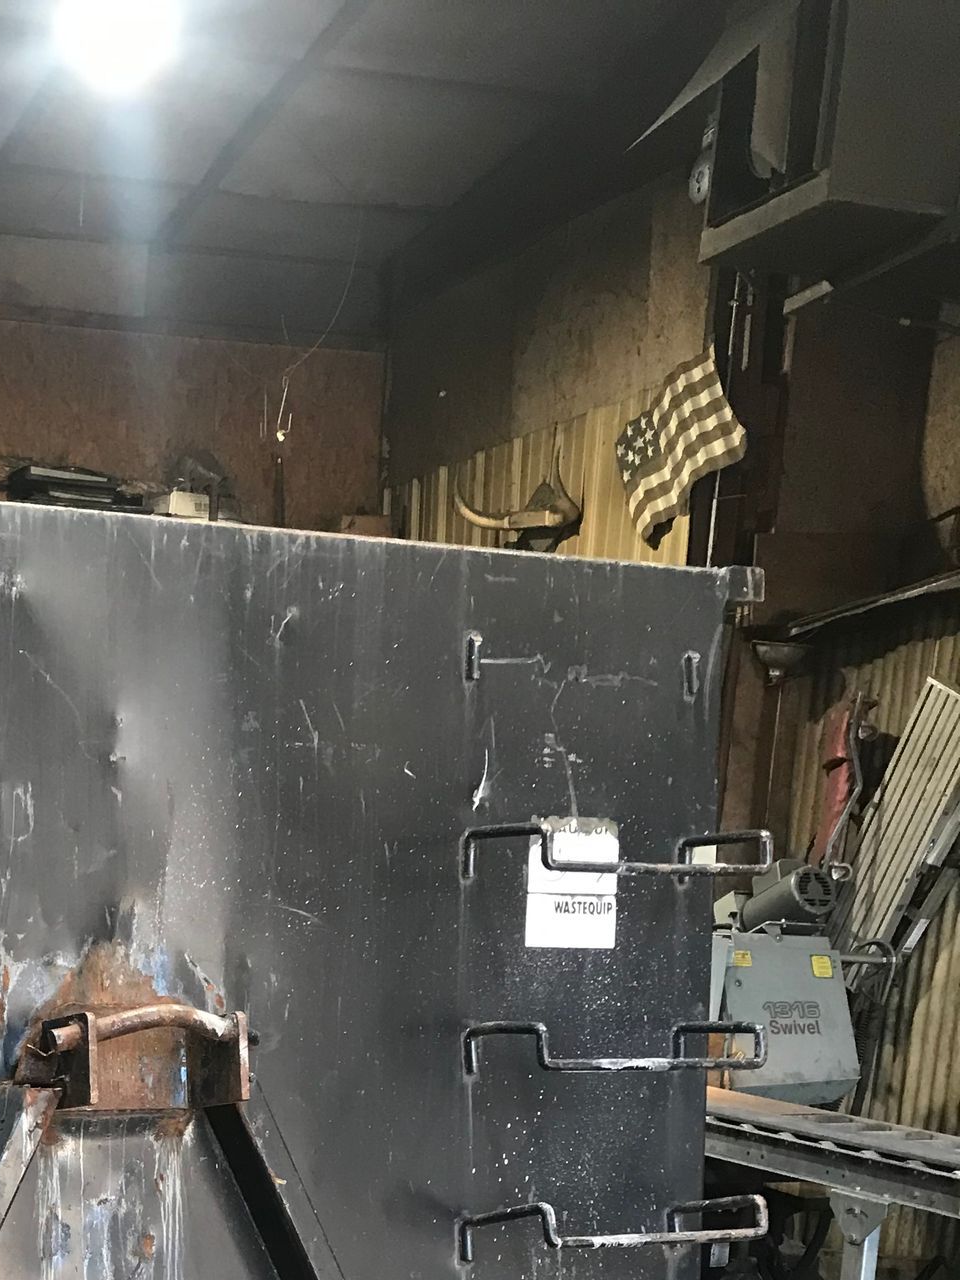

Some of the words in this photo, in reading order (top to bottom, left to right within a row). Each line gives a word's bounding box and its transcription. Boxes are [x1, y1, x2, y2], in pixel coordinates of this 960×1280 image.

[554, 900, 614, 915] WASTEQUIP
[762, 1001, 821, 1020] 1316
[769, 1020, 822, 1035] Swivel
